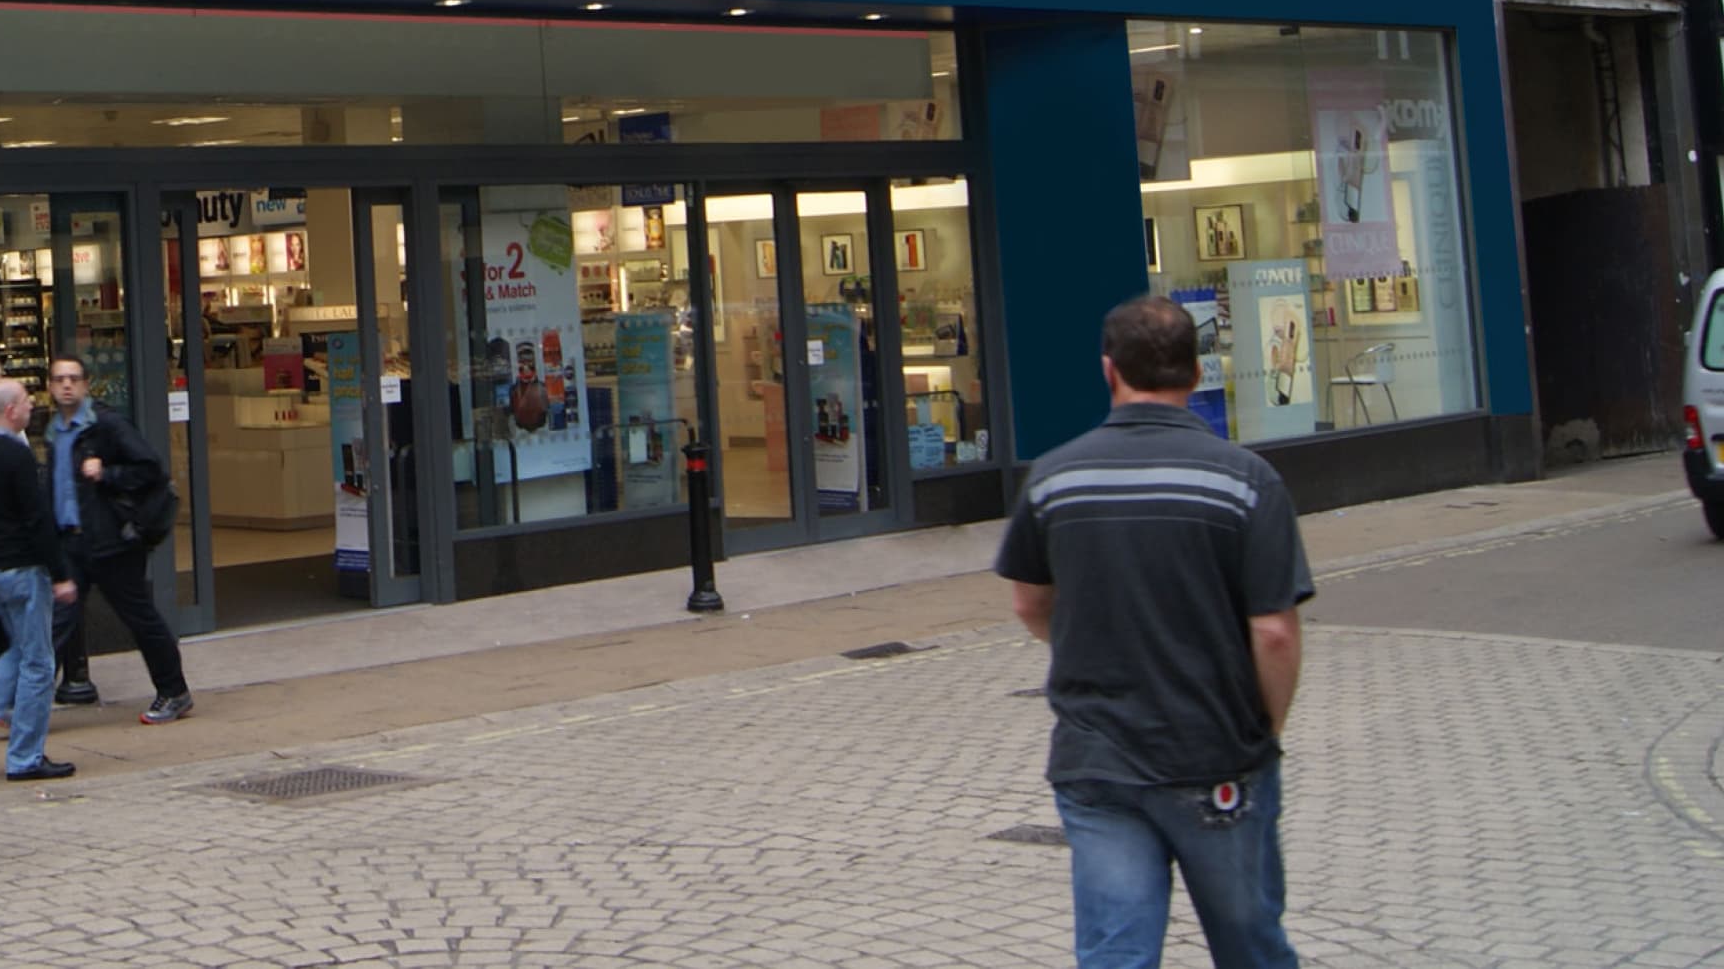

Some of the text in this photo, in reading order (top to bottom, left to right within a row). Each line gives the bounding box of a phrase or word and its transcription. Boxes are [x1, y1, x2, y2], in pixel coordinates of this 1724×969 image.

[256, 197, 287, 213] new
[505, 241, 526, 280] 2
[497, 282, 537, 299] Match
